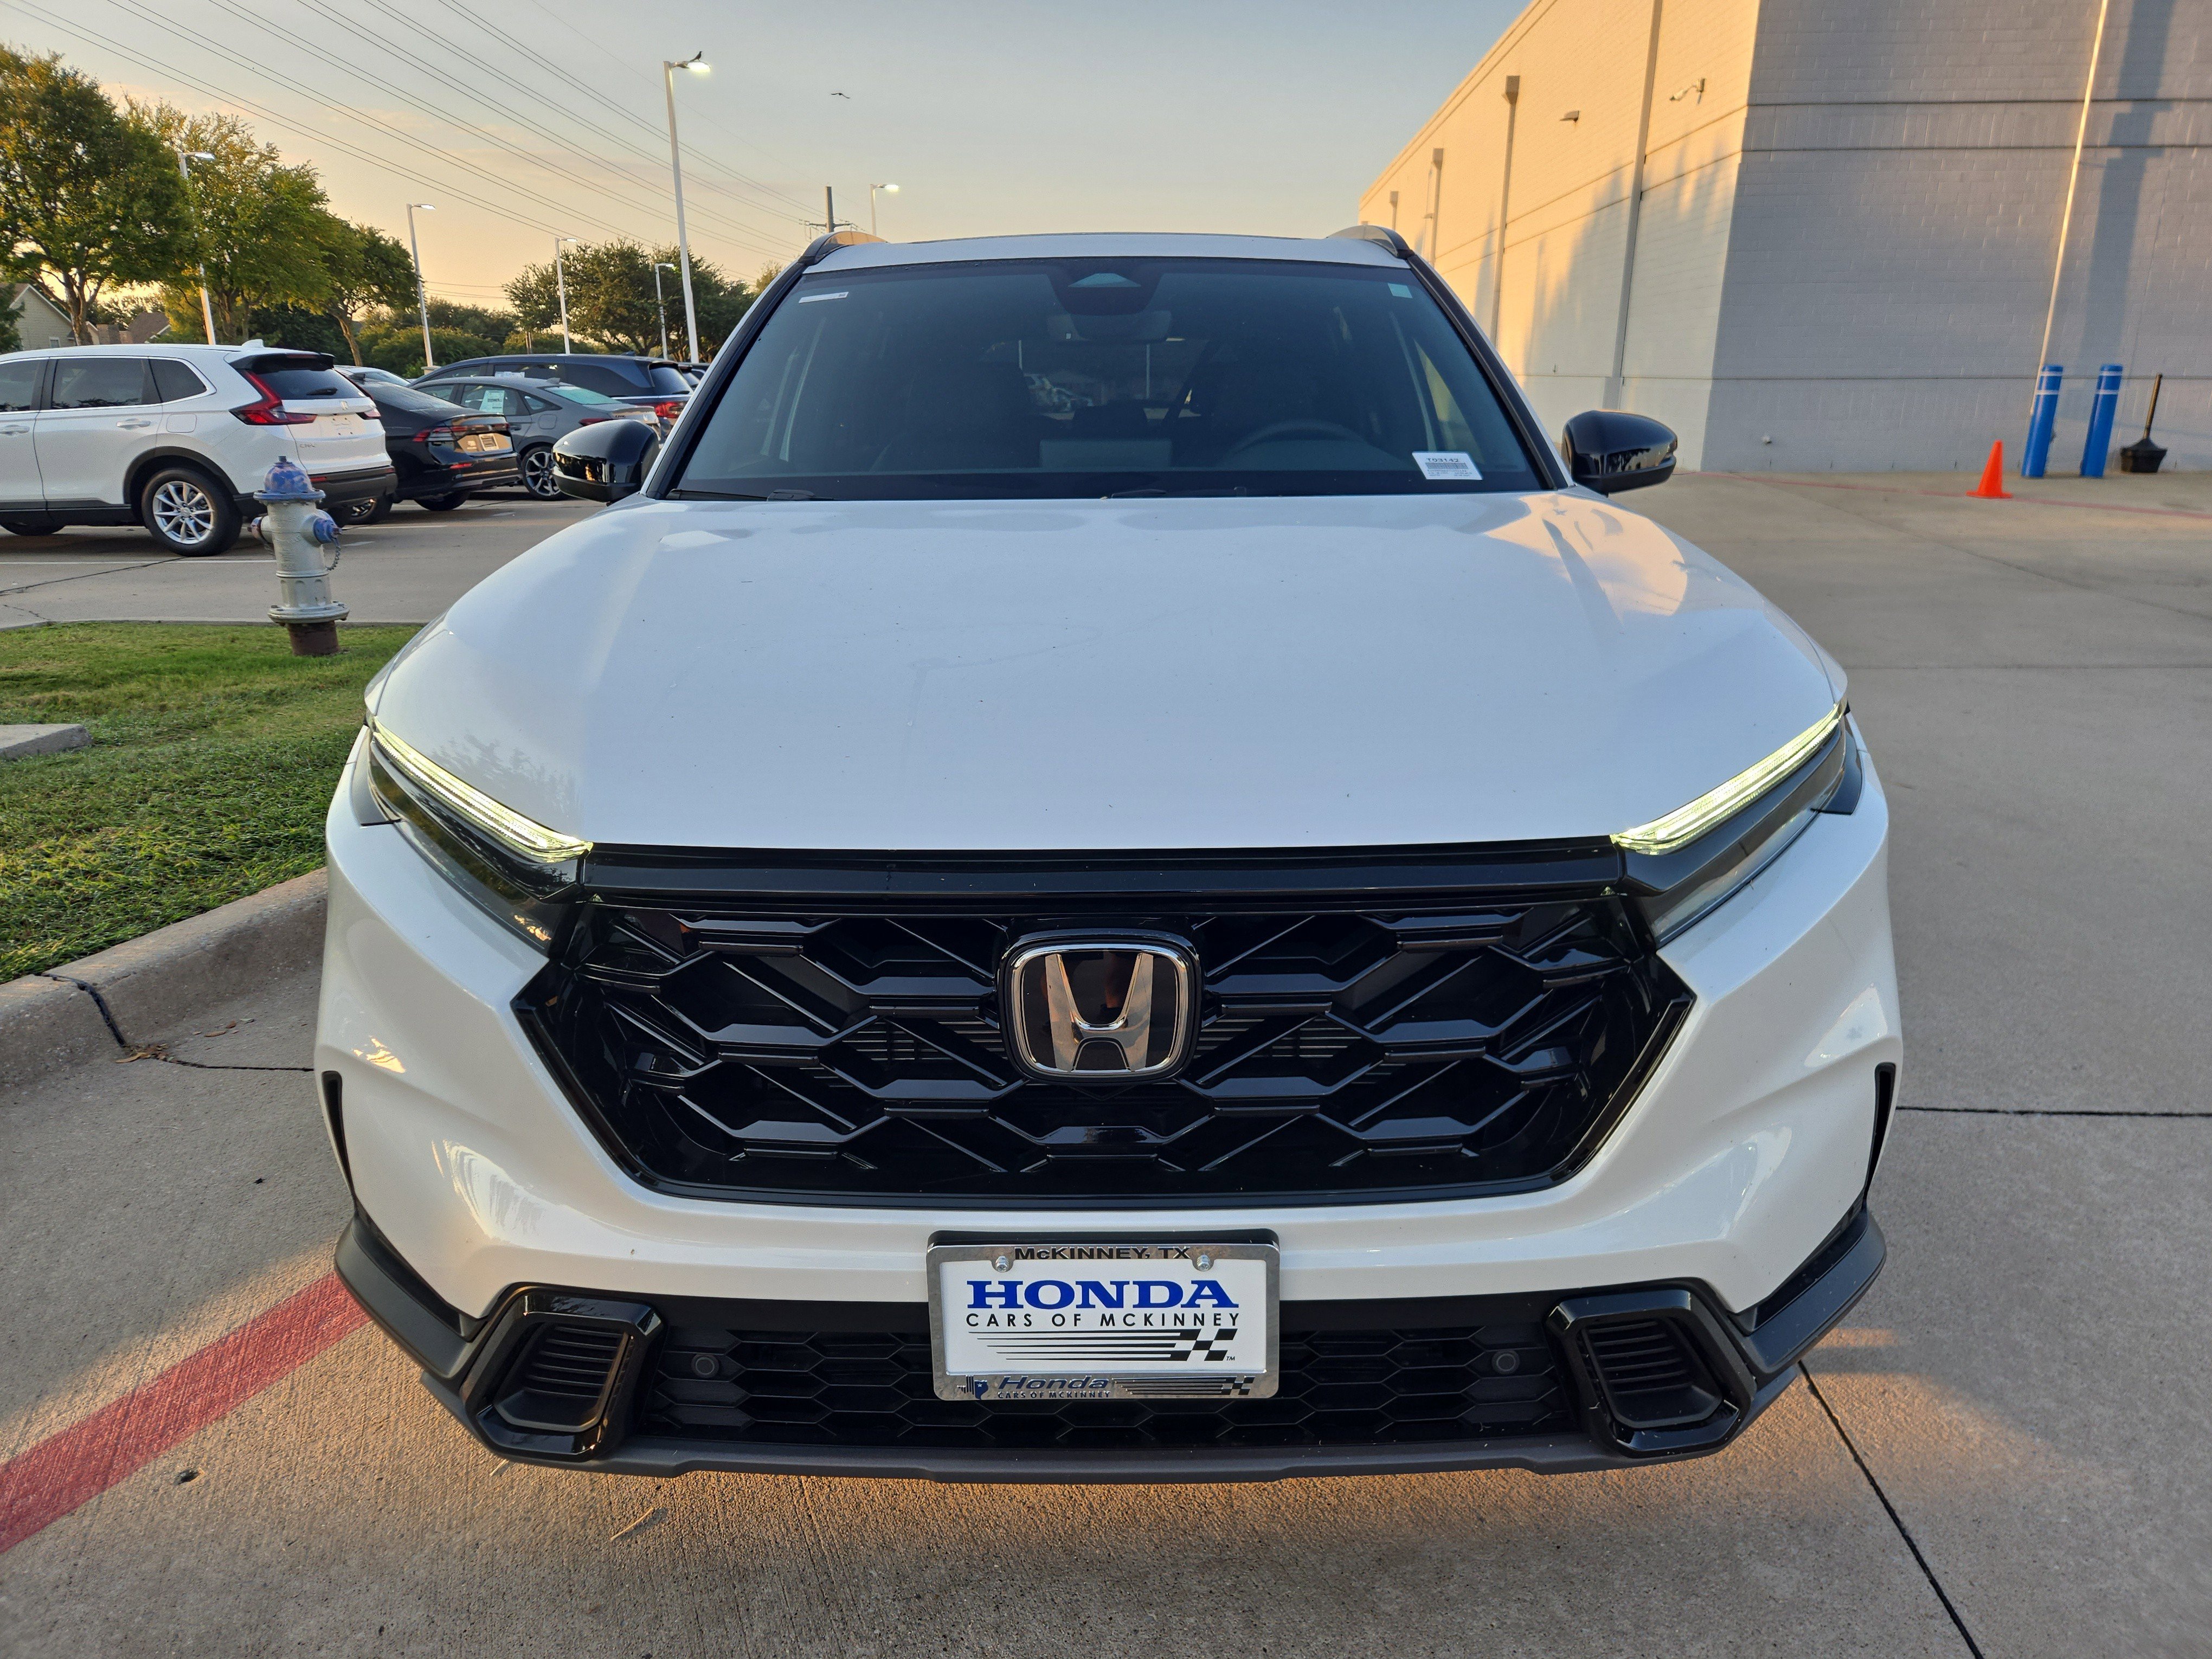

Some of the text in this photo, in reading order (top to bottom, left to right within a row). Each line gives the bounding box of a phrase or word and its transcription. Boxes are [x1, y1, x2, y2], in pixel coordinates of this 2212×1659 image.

[1014, 1246, 1191, 1260] McKINNEY, TX
[966, 1279, 1239, 1309] HONDA
[966, 1313, 1239, 1327] CARS OF MCKINNEY
[998, 1375, 1110, 1390] Honda
[998, 1390, 1110, 1399] CARS OF MCKINNEY
